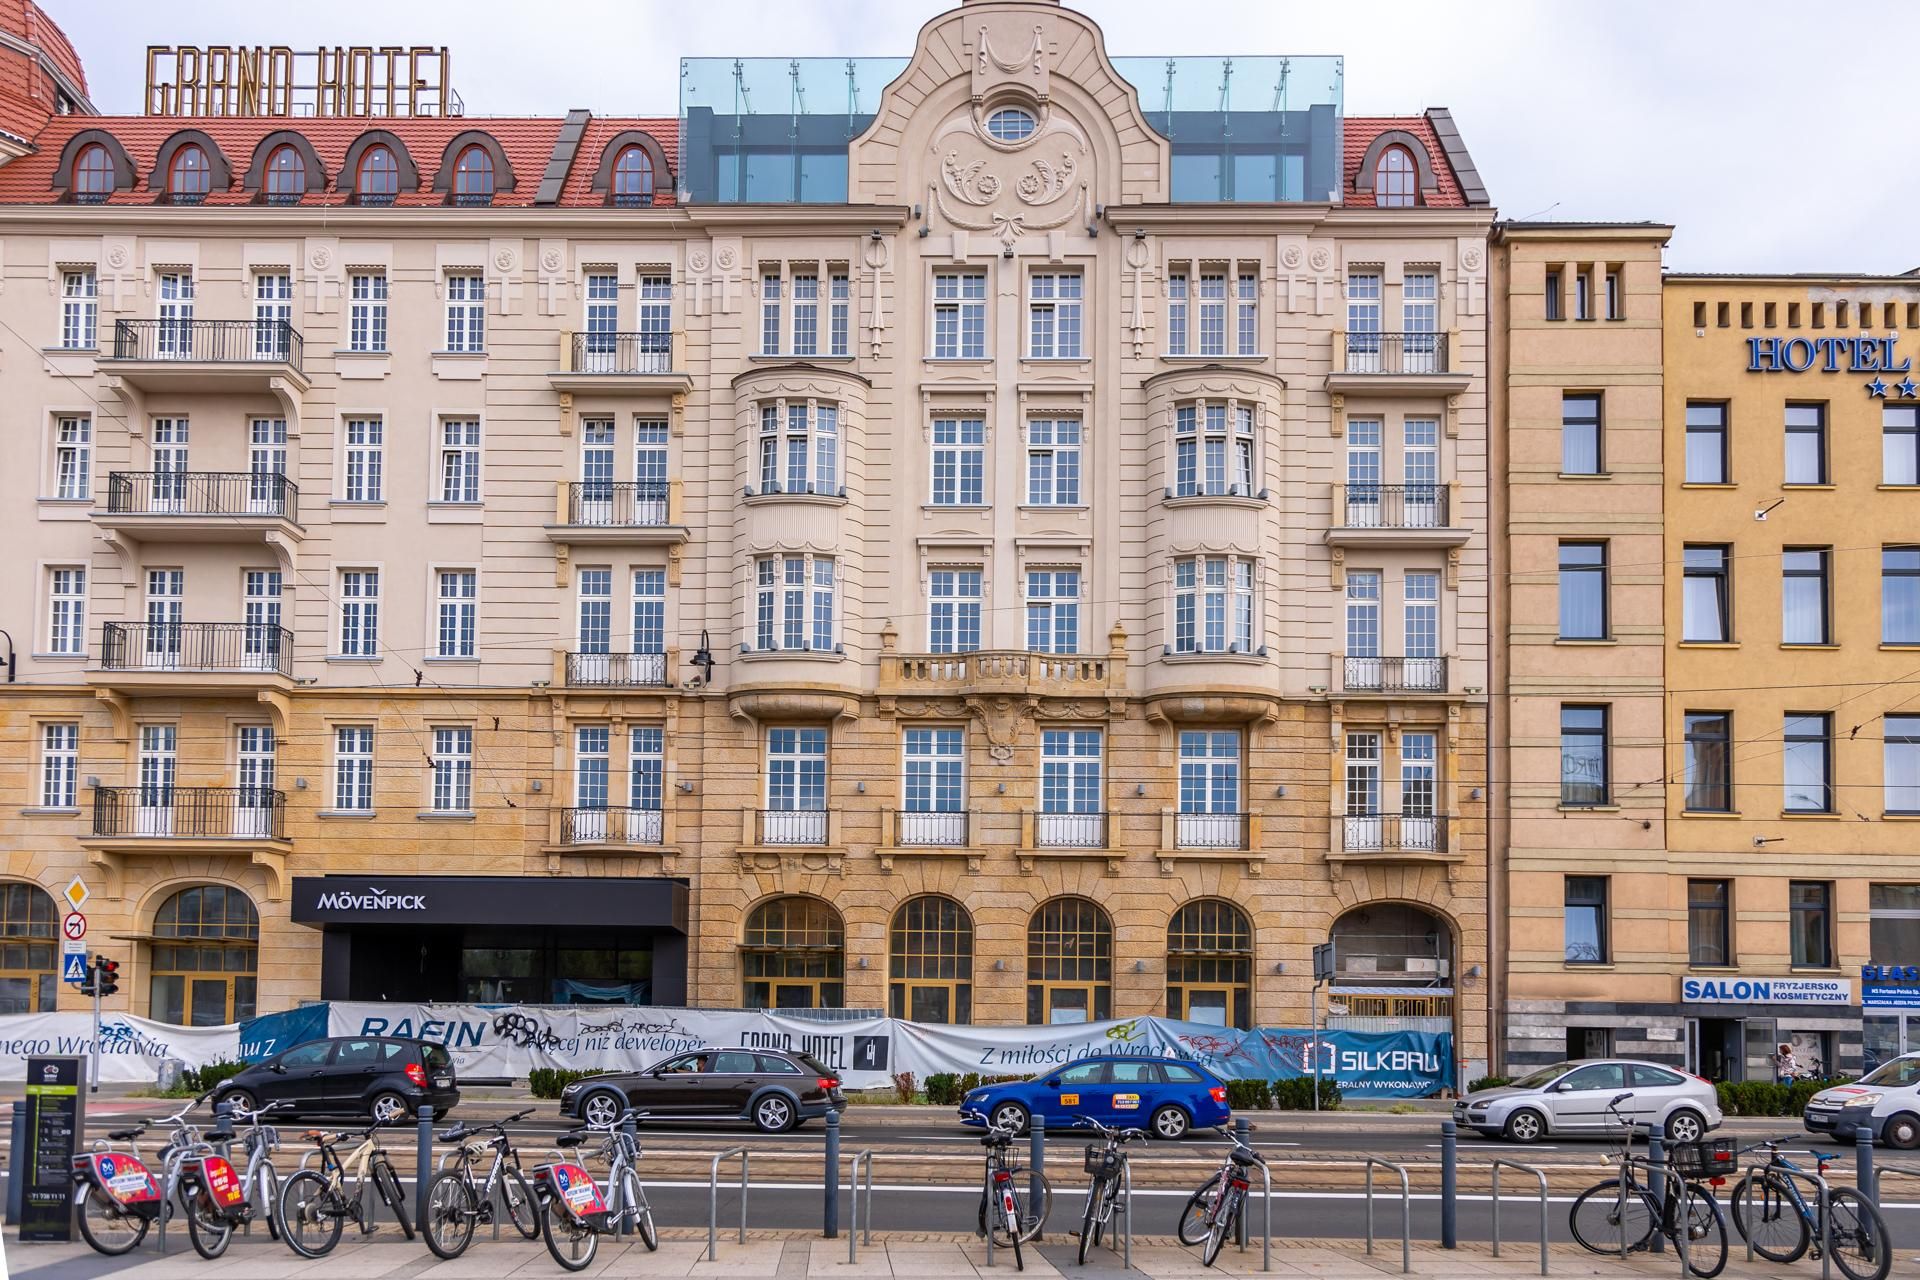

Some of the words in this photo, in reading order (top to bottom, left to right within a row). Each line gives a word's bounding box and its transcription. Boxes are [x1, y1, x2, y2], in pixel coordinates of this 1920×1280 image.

[147, 46, 294, 117] GRAND
[319, 46, 463, 118] HOTEL
[1747, 336, 1911, 373] HOTEL
[317, 890, 426, 910] MÖVENPICK
[1684, 981, 1770, 1000] SALON
[1773, 982, 1838, 991] FRYZJERSKO
[1773, 992, 1848, 1001] KOSMETYCZNY
[360, 1018, 487, 1047] RAFIN
[585, 1033, 610, 1051] niż
[615, 1032, 706, 1055] deweloper
[980, 1047, 995, 1065] Z
[1000, 1041, 1071, 1065] miłości
[1077, 1042, 1101, 1060] do
[1109, 1041, 1213, 1067] Wrocłwia
[1341, 1050, 1440, 1073] SILKBAU
[1373, 1080, 1435, 1089] WYKONAWC
